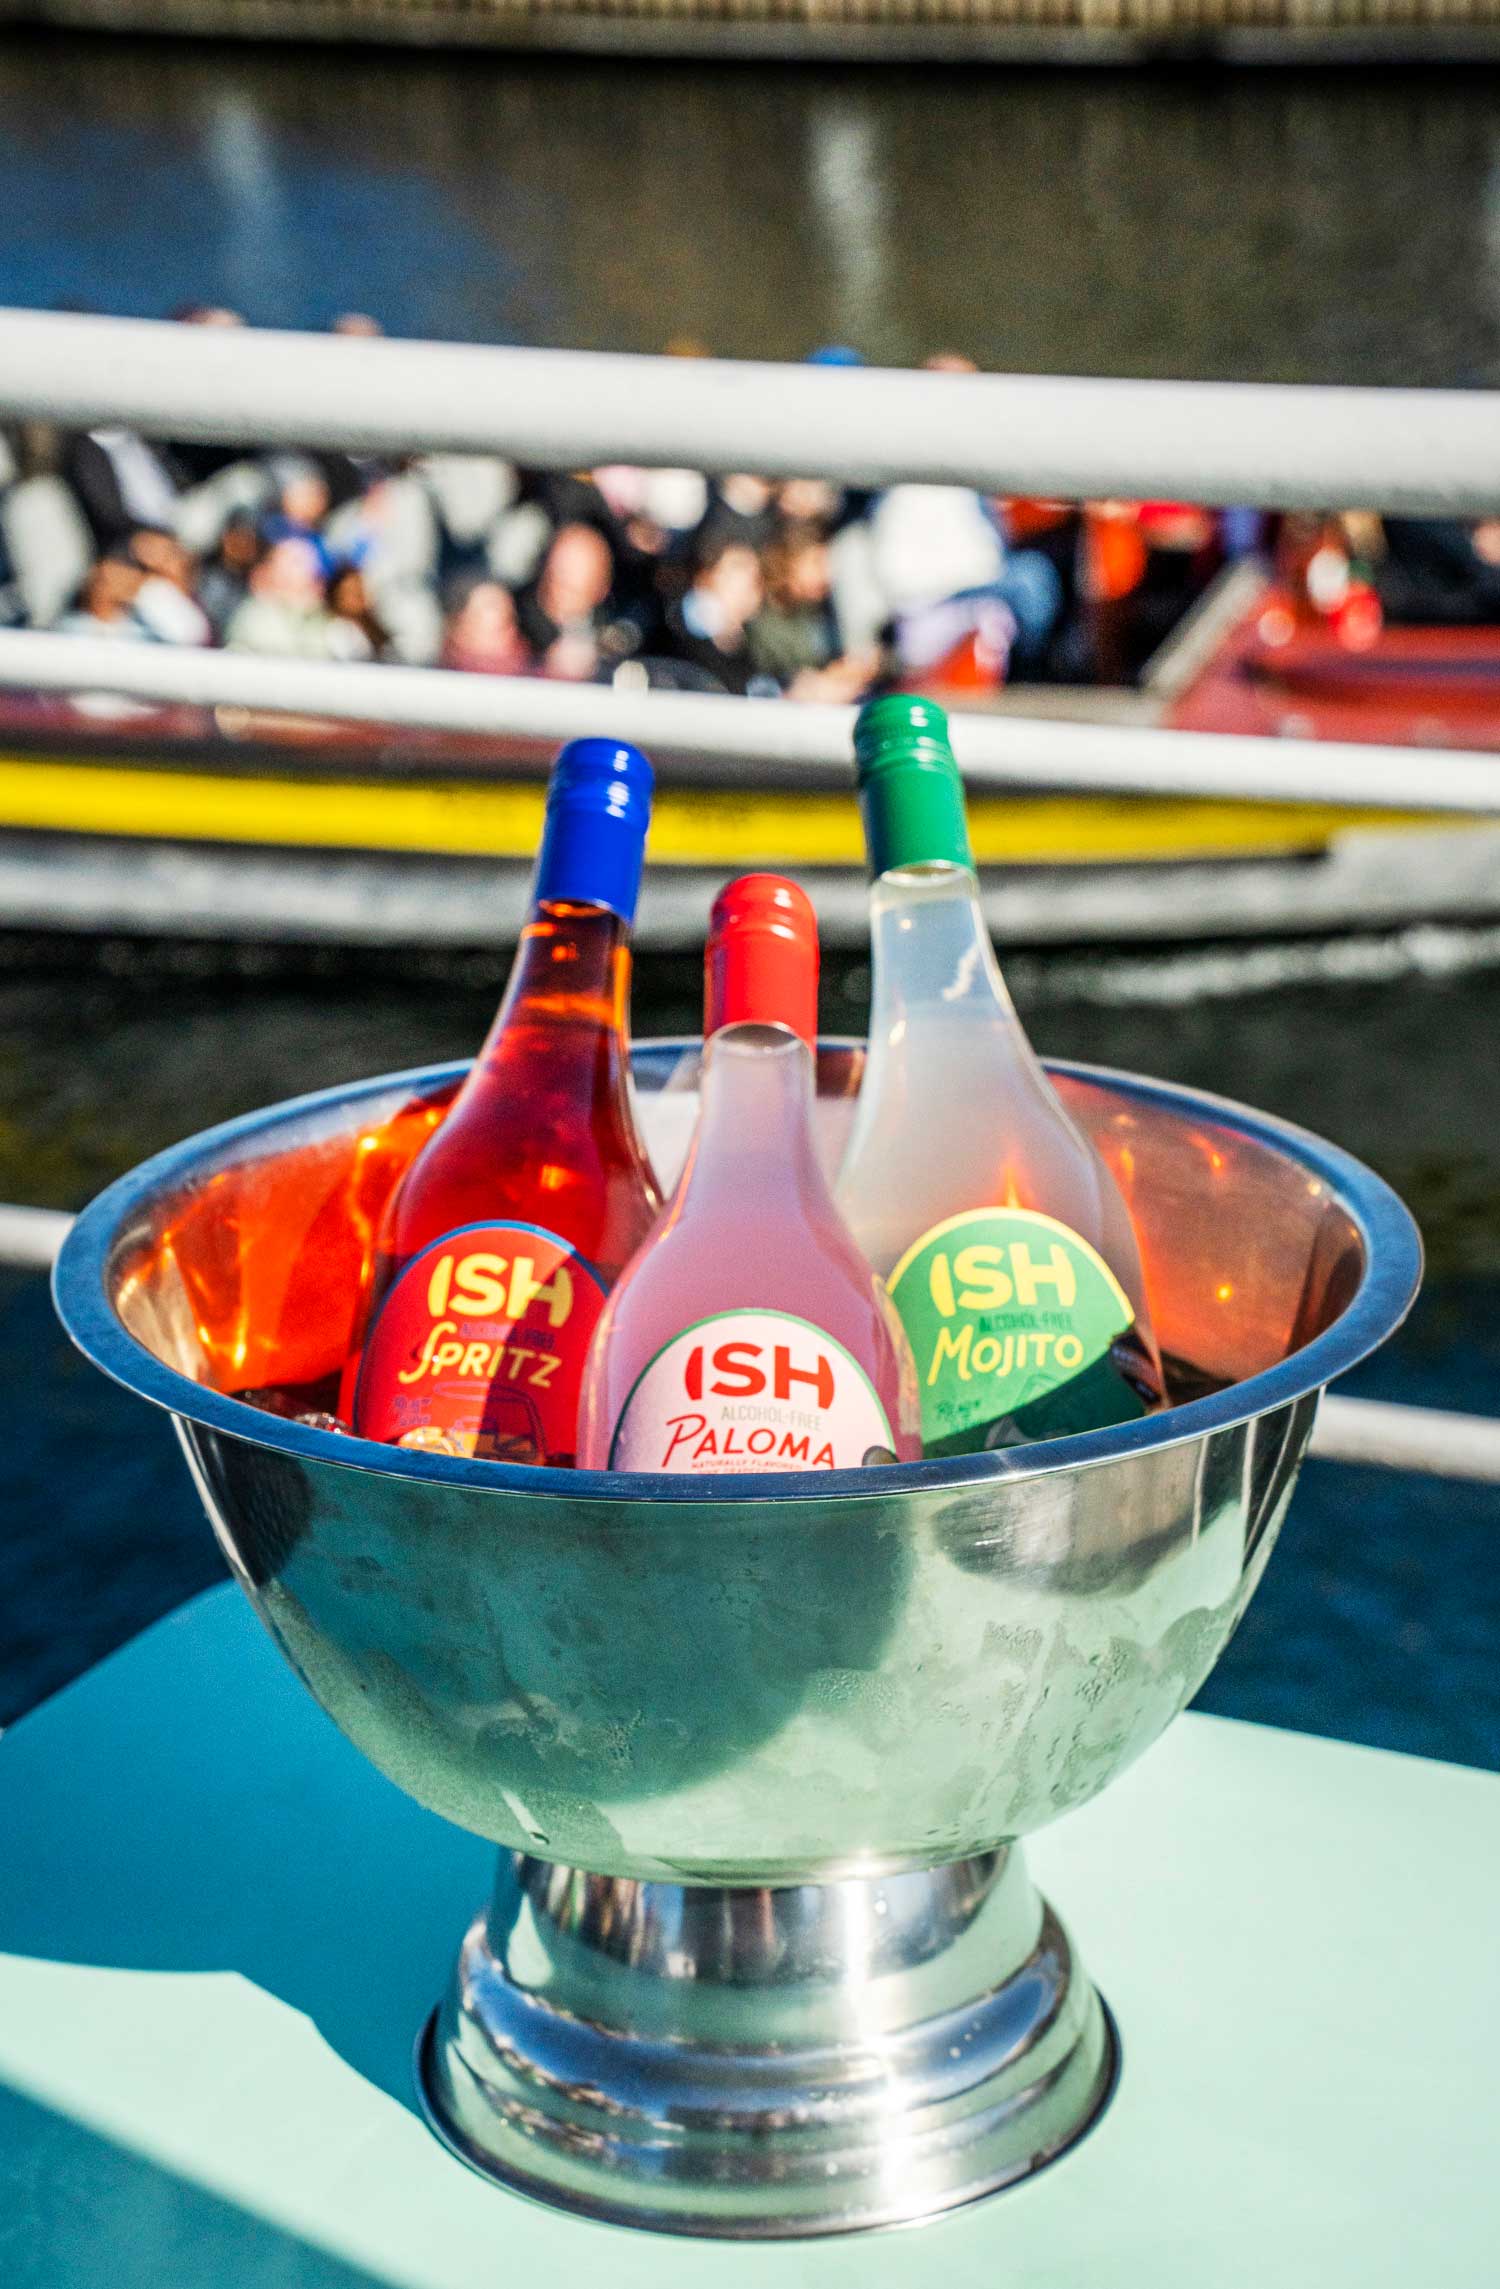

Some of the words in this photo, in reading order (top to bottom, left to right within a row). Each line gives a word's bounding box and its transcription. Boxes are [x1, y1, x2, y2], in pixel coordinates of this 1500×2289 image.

[427, 1253, 573, 1328] ISH
[929, 1242, 1077, 1318] ISH
[397, 1321, 562, 1388] SPRITZ
[684, 1342, 835, 1410] ISH
[927, 1324, 1084, 1386] MOJITO
[661, 1414, 836, 1470] PALOMA
[720, 1406, 823, 1432] ALCOHOL-FREE
